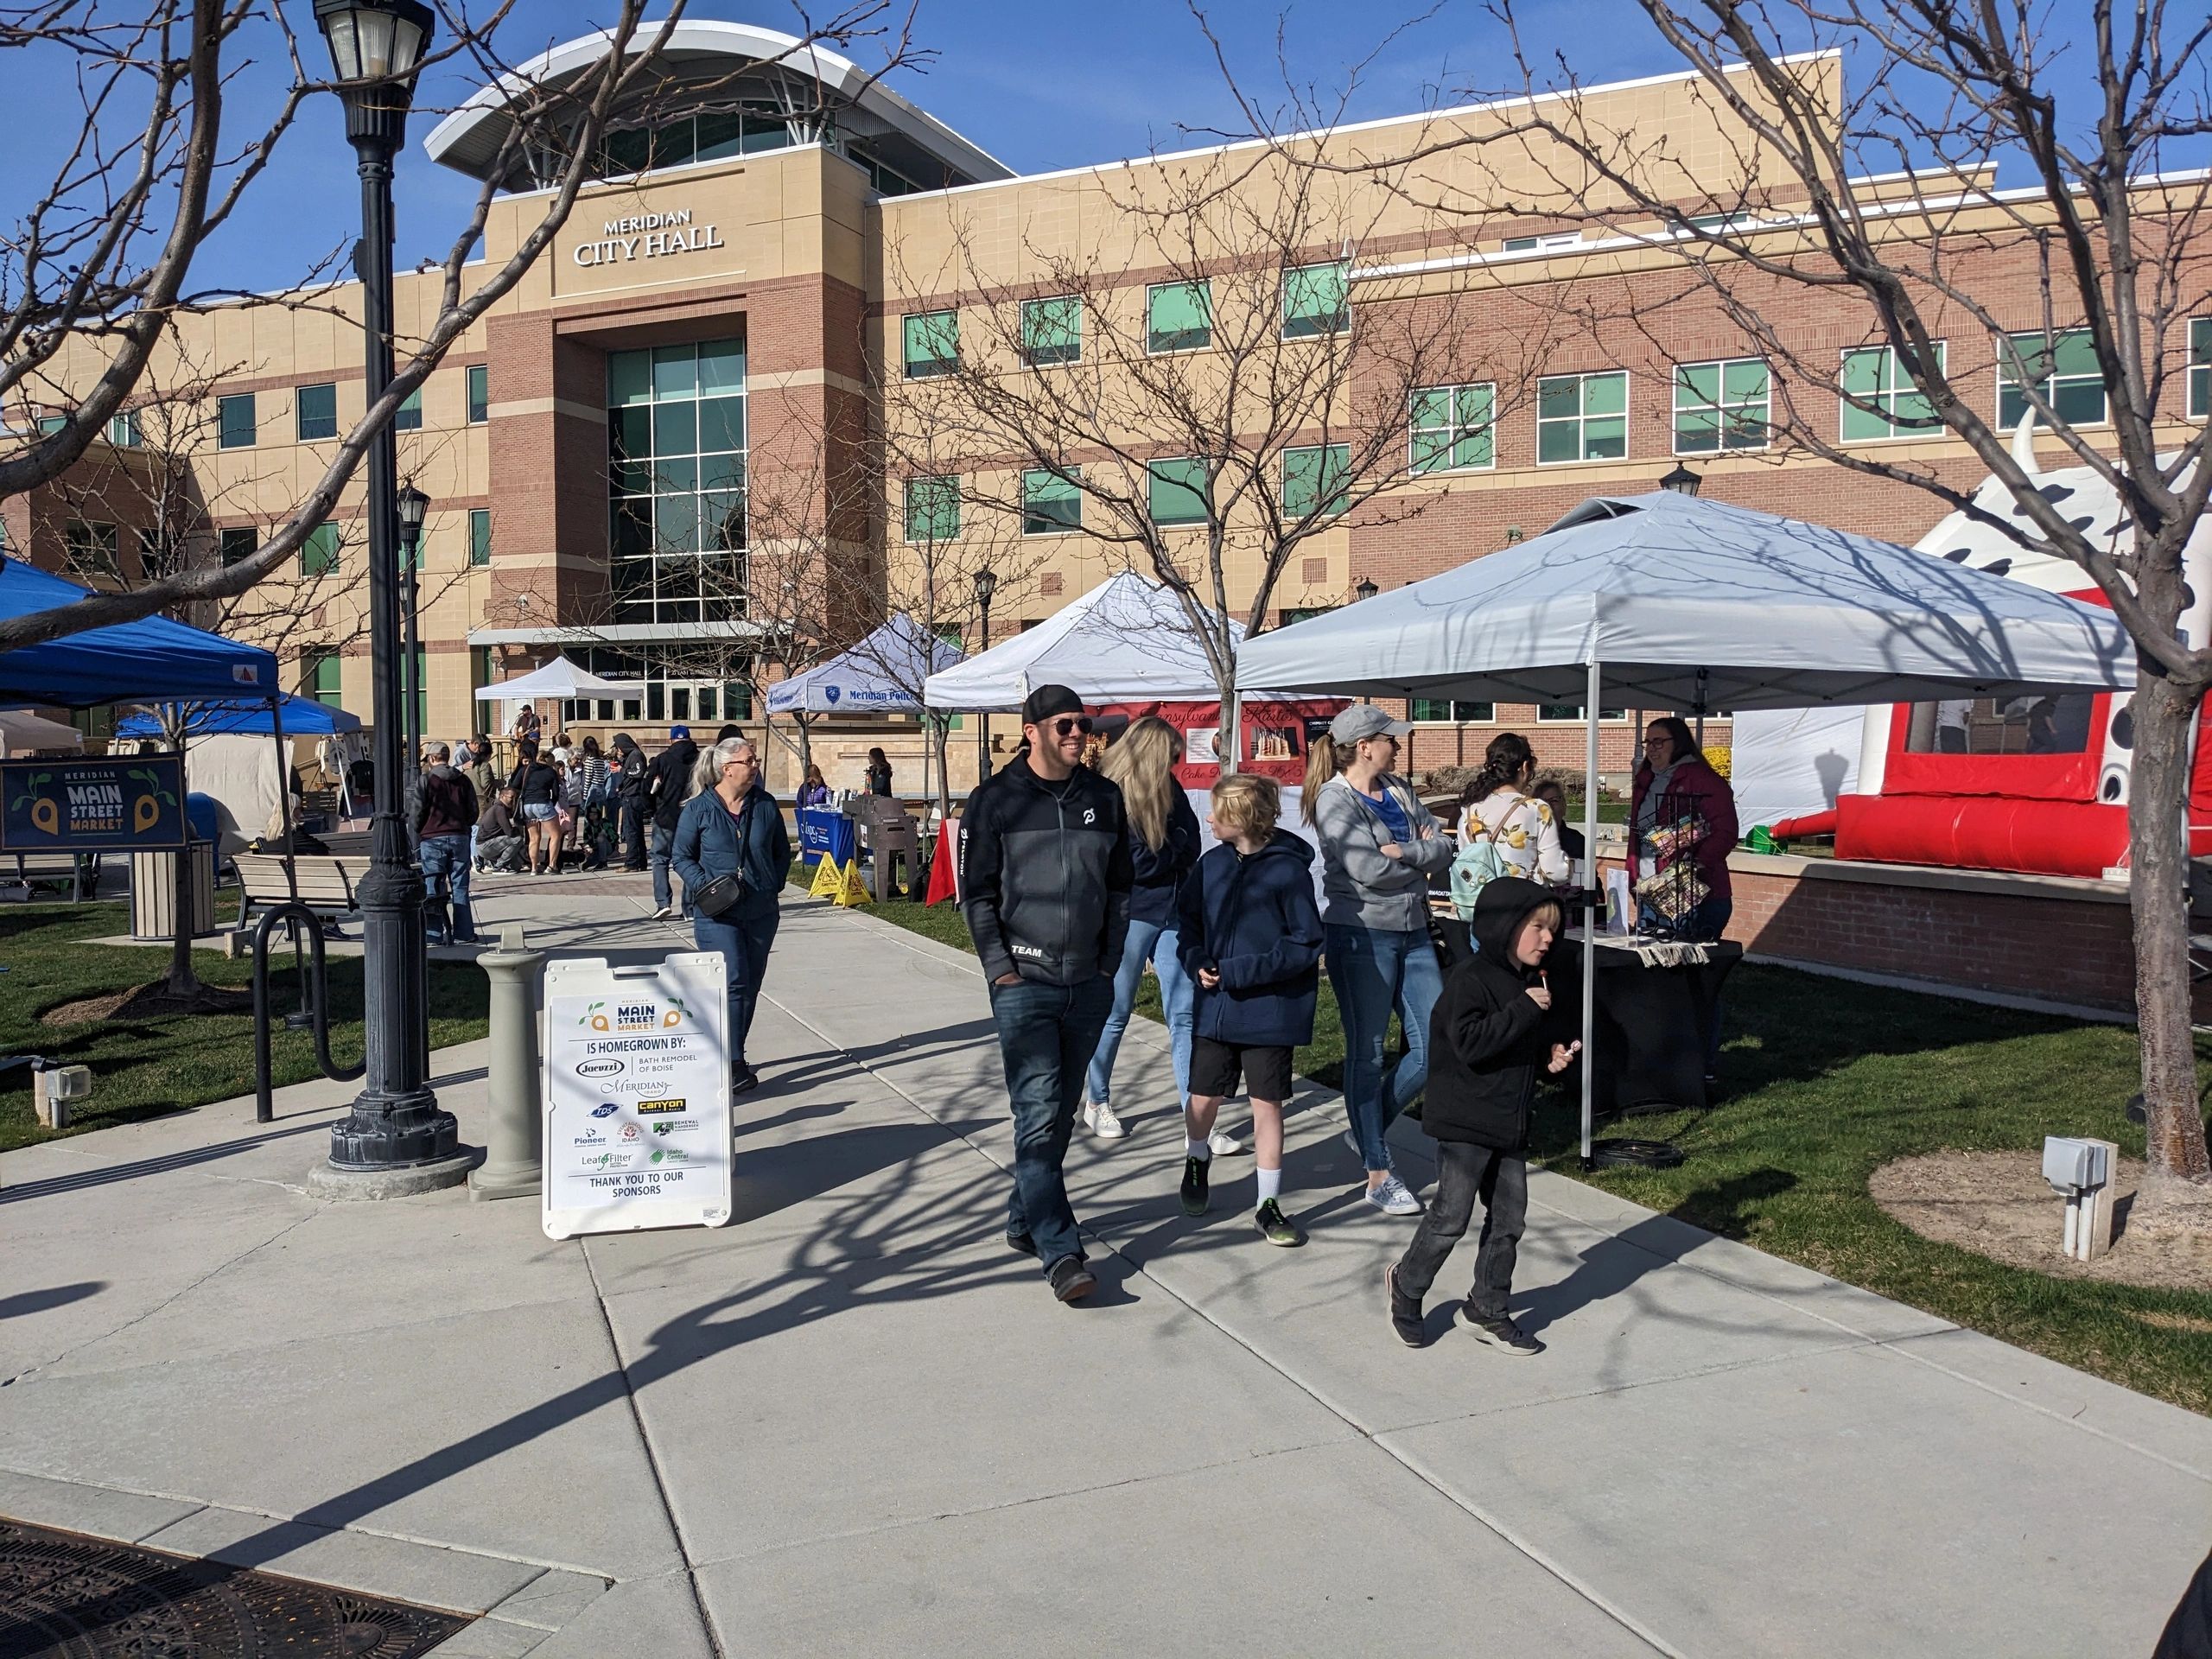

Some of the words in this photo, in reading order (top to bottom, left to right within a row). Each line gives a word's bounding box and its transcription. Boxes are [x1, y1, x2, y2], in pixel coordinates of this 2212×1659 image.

[604, 209, 690, 235] MERIDIAN
[573, 236, 639, 266] CITY
[644, 225, 723, 257] HALL
[849, 690, 887, 701] Meridian
[65, 771, 116, 779] MERIDIAN
[67, 785, 123, 805] MAIN
[70, 804, 124, 819] STREET
[70, 818, 124, 831] MARKET
[1011, 945, 1042, 957] TEAM
[618, 1005, 655, 1017] MAIN
[618, 1016, 655, 1025] STREET
[587, 1042, 596, 1054] IS
[599, 1039, 668, 1053] HOMEGROWN
[671, 1037, 686, 1048] BY:
[582, 1062, 619, 1073] Jacuzzi
[590, 1176, 621, 1187] THANK
[625, 1174, 645, 1185] YOU
[648, 1173, 660, 1183] TO
[664, 1172, 683, 1182] OUR
[613, 1185, 661, 1198] SPONSORS
